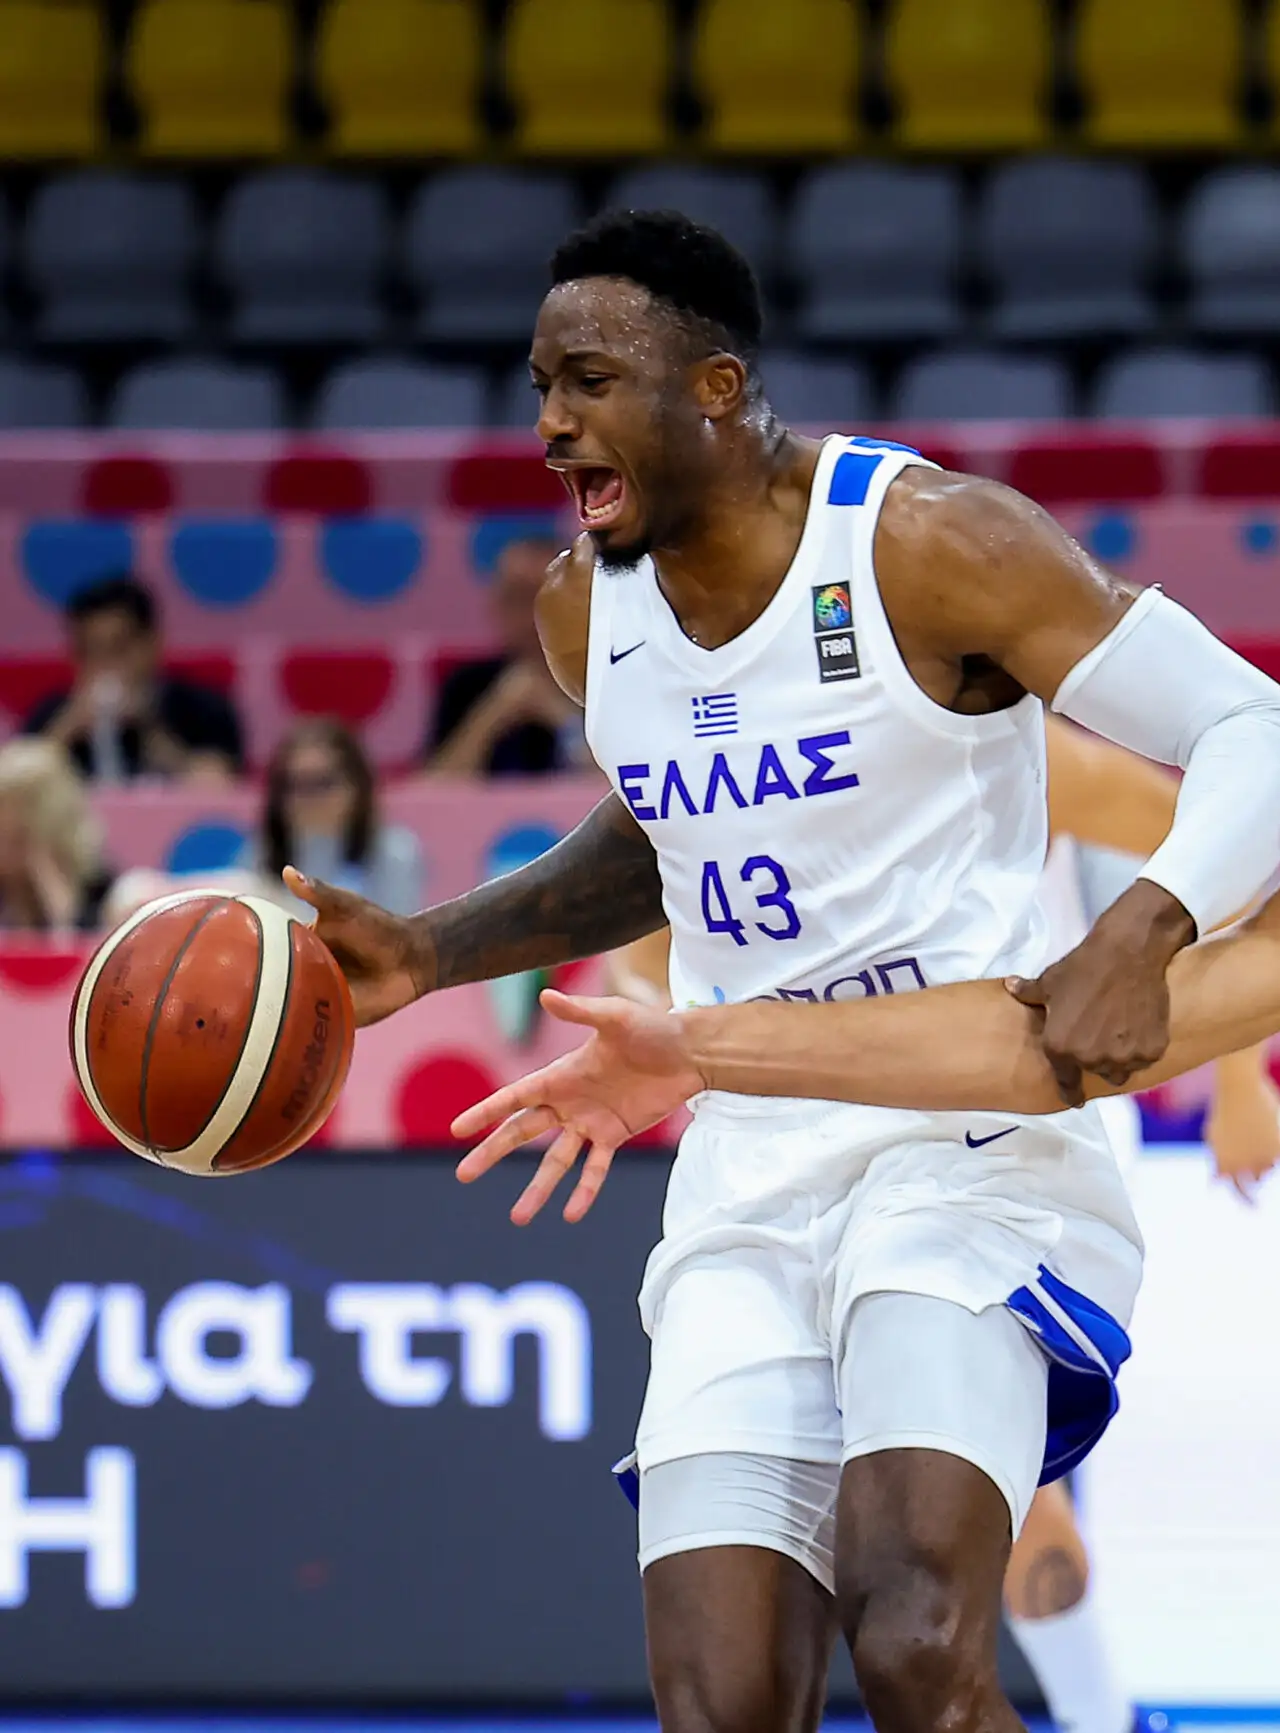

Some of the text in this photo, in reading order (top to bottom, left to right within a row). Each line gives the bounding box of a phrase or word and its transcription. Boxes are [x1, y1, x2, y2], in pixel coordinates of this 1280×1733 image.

[820, 637, 853, 658] FIBA
[617, 730, 860, 821] ΕΛΛΑΣ
[700, 855, 803, 947] 43
[325, 1280, 594, 1443] τη
